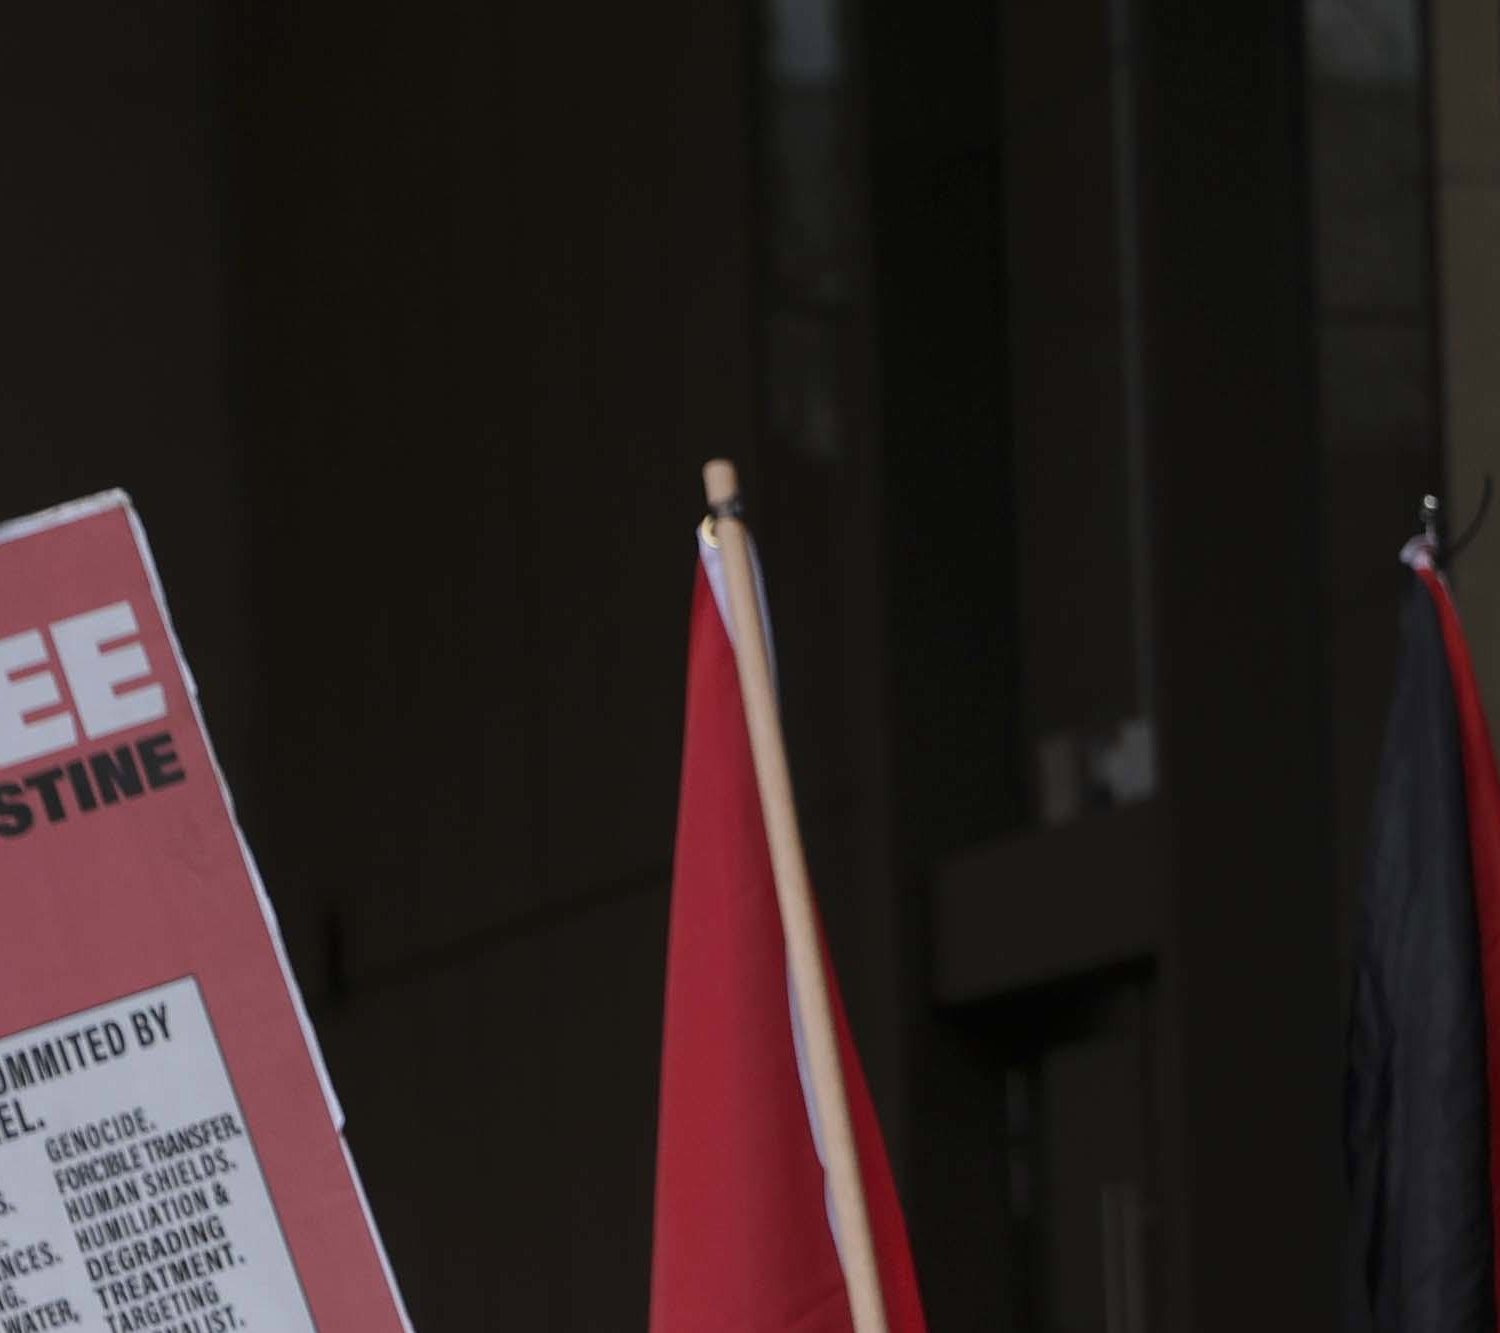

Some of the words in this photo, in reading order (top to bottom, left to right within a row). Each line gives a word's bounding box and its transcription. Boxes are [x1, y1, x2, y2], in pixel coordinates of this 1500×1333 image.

[129, 1002, 172, 1049] BY
[45, 1107, 156, 1164] GENOCIDE.
[54, 1144, 144, 1195] FORCIBLE
[64, 1178, 141, 1224] HUMAN
[142, 1148, 236, 1198] SHIELDS.
[74, 1187, 210, 1253] HUMILIATION
[212, 1181, 230, 1207] &
[84, 1215, 226, 1284] DEGRADING
[93, 1242, 244, 1312] TREATMENT.
